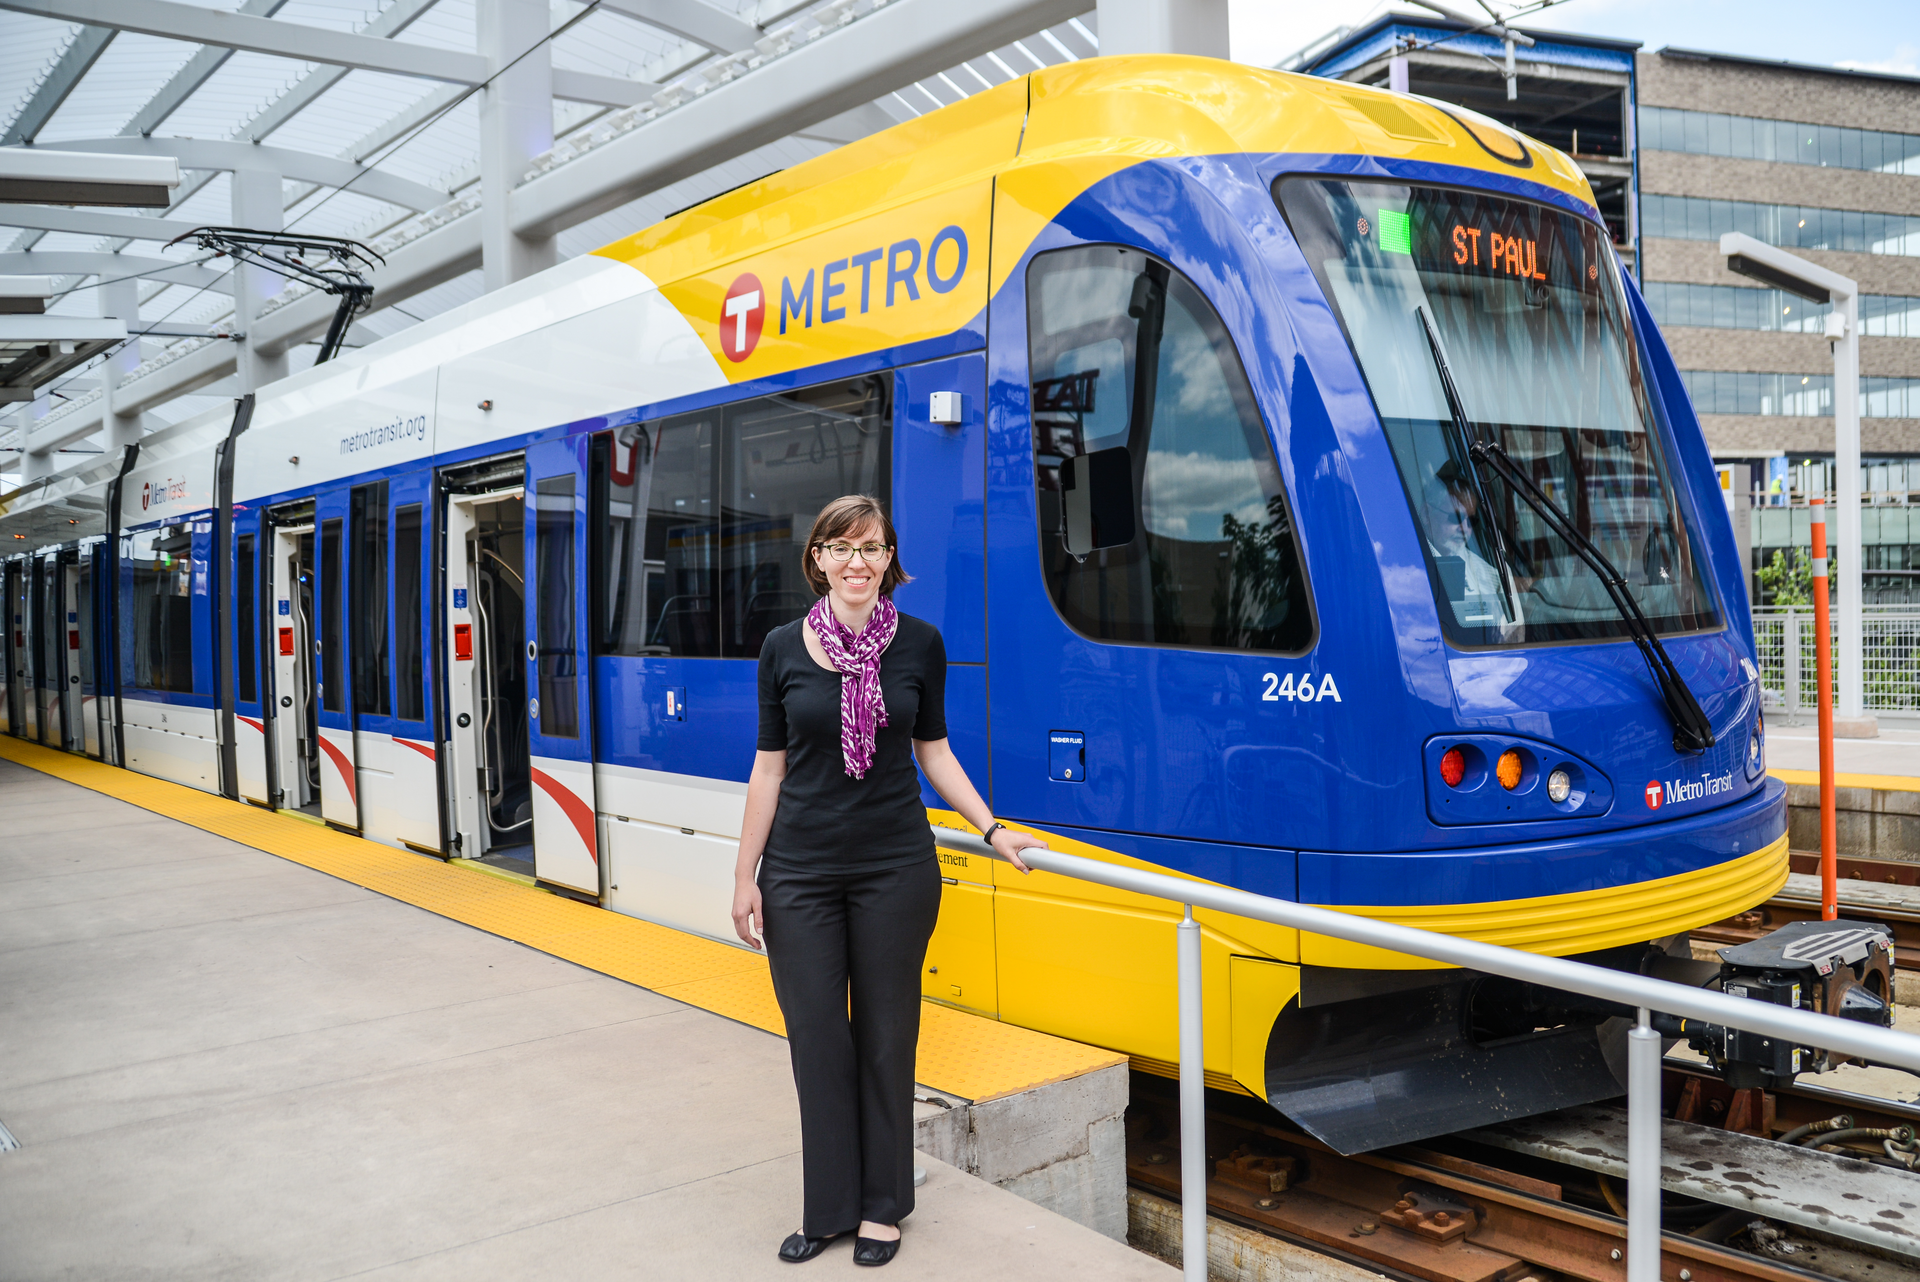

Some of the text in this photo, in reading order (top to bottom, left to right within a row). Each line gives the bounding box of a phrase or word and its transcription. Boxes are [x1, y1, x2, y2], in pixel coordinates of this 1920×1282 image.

[1453, 225, 1546, 280] ST PAUL
[725, 224, 969, 353] T METRO
[339, 415, 426, 455] metrotransit.org
[1262, 672, 1342, 702] 246A
[1647, 786, 1661, 807] T
[937, 852, 968, 867] ement
